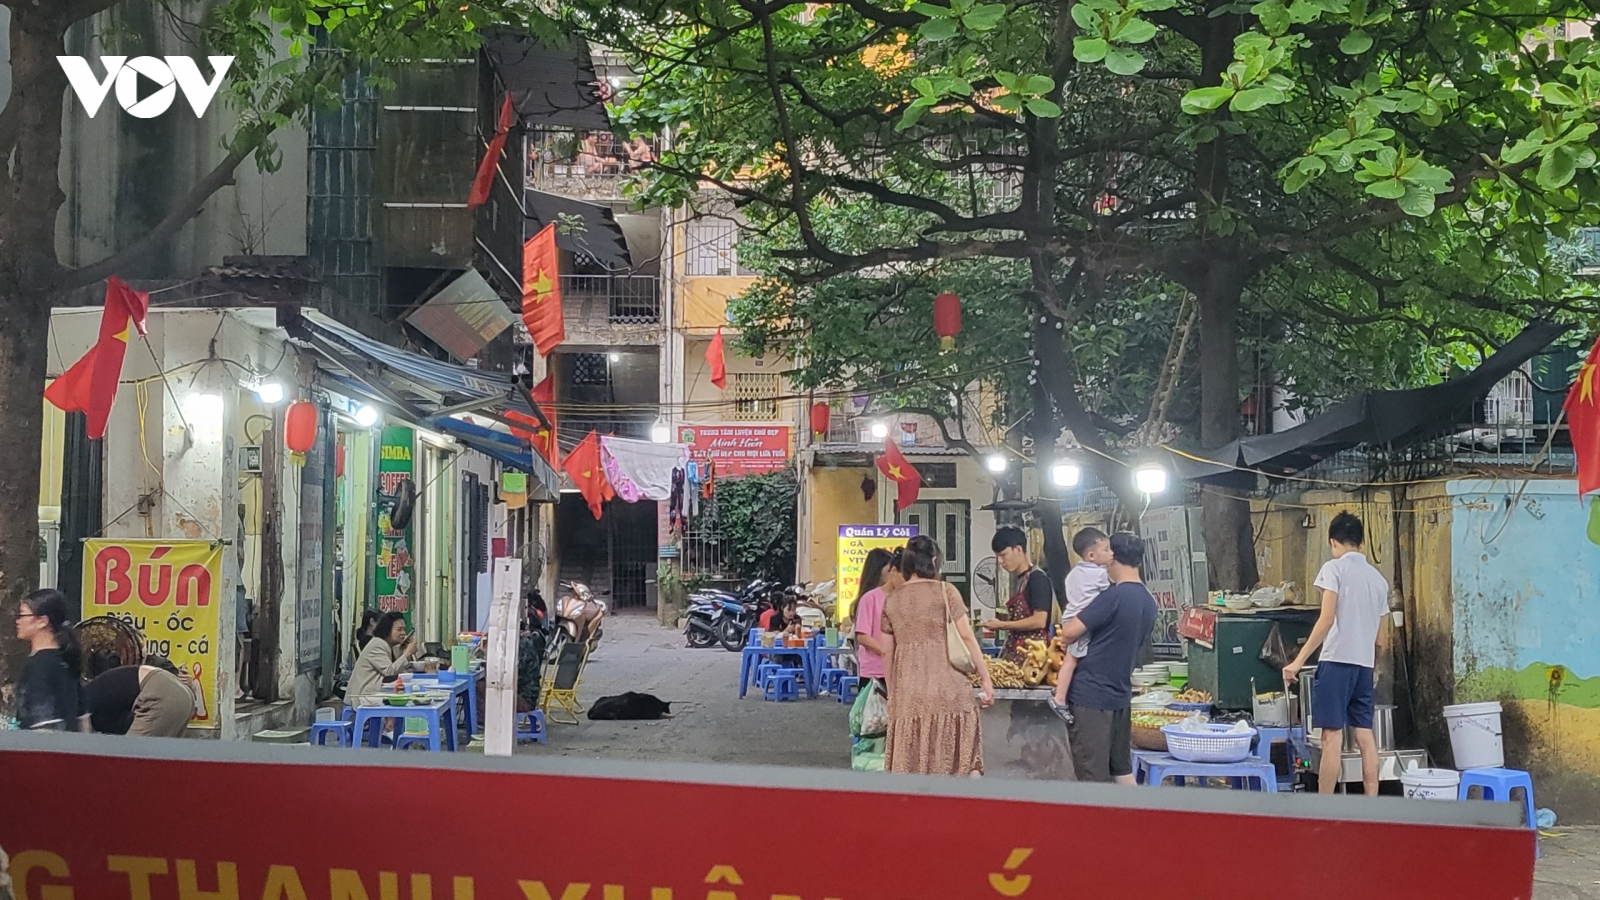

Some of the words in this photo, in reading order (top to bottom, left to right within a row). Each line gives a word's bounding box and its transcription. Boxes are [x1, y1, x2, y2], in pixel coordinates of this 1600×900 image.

[710, 438, 737, 447] Minh
[381, 445, 411, 460] SIMBA
[845, 527, 874, 537] Quán
[876, 527, 890, 537] Lý
[892, 527, 911, 537] Còi
[94, 545, 212, 607] Bún
[166, 610, 194, 631] ốc
[187, 634, 209, 655] cá
